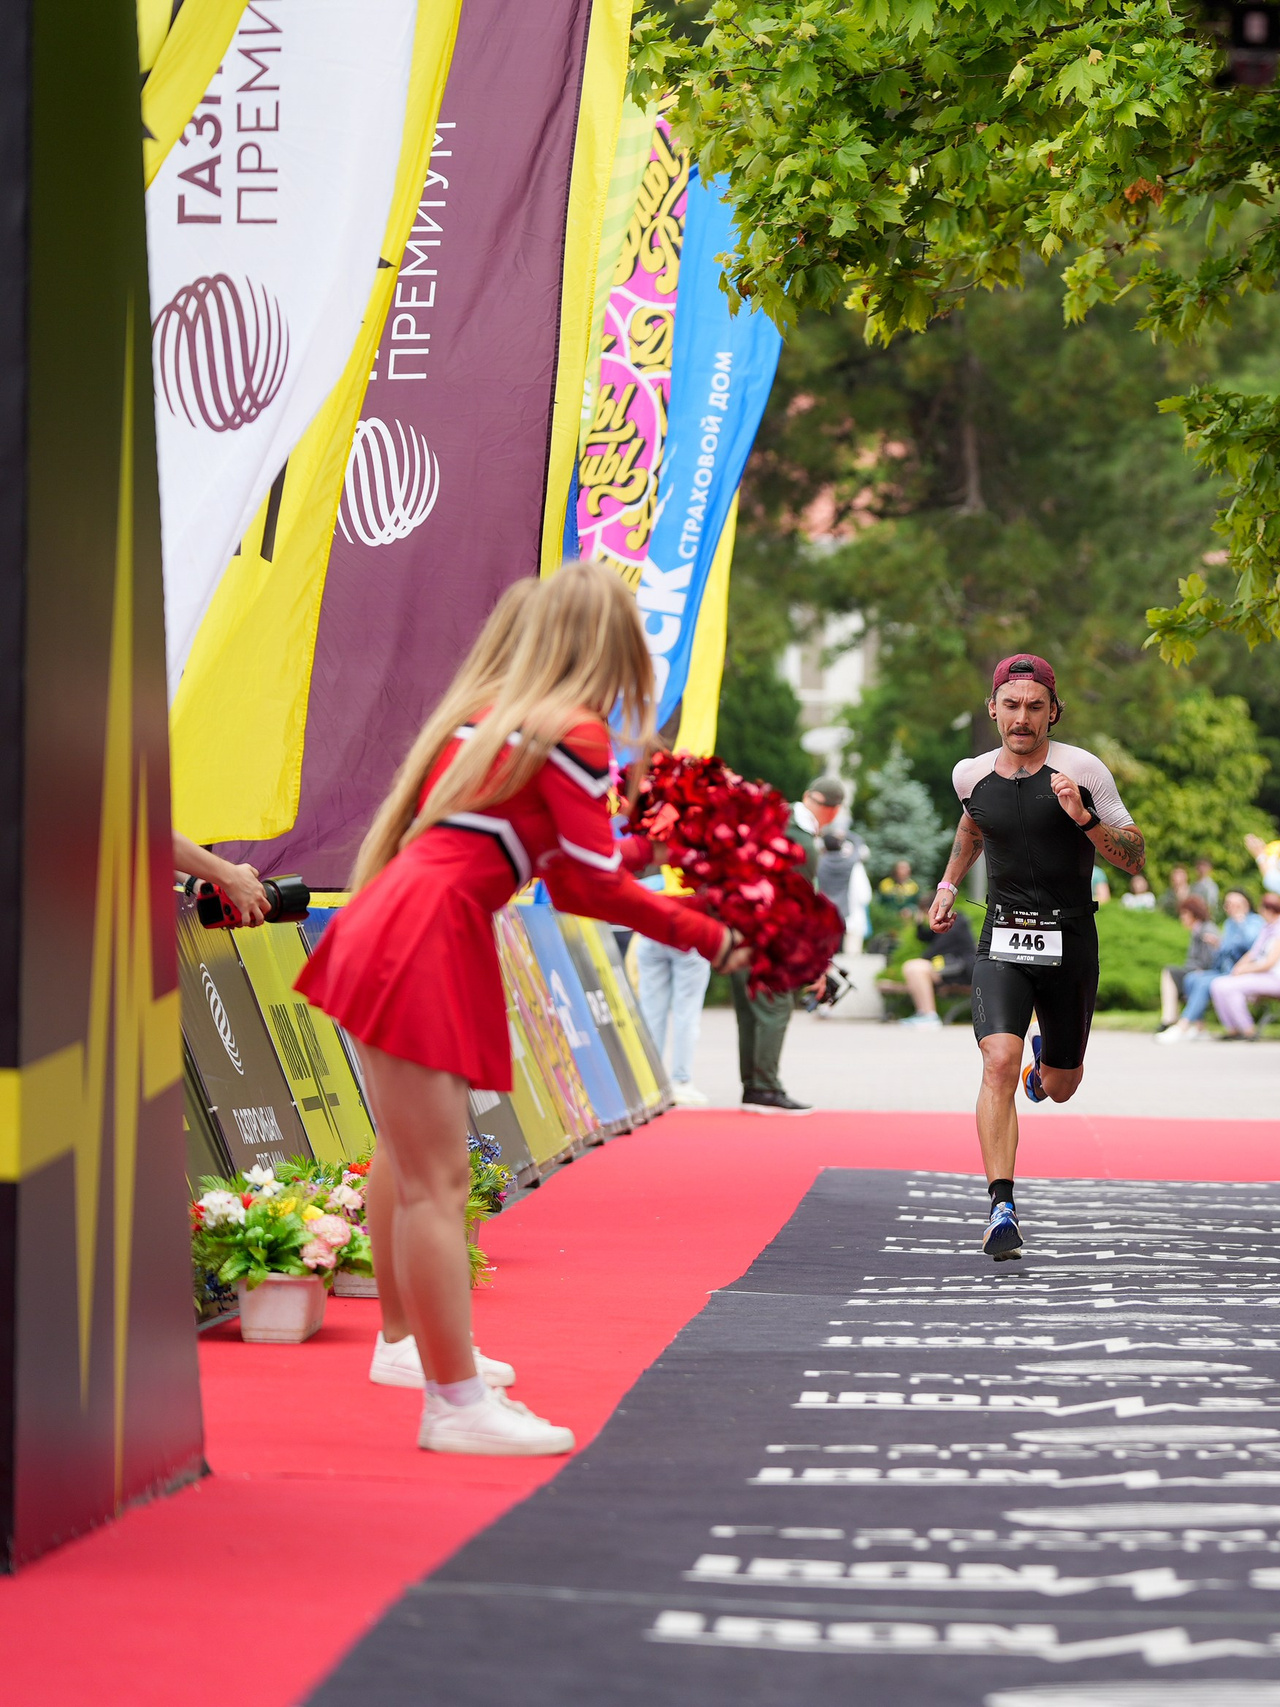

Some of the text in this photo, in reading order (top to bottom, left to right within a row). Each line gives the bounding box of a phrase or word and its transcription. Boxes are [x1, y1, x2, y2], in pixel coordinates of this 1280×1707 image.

[678, 350, 733, 560] СТРАХОВОЙ ДОМ
[1009, 933, 1045, 951] 446
